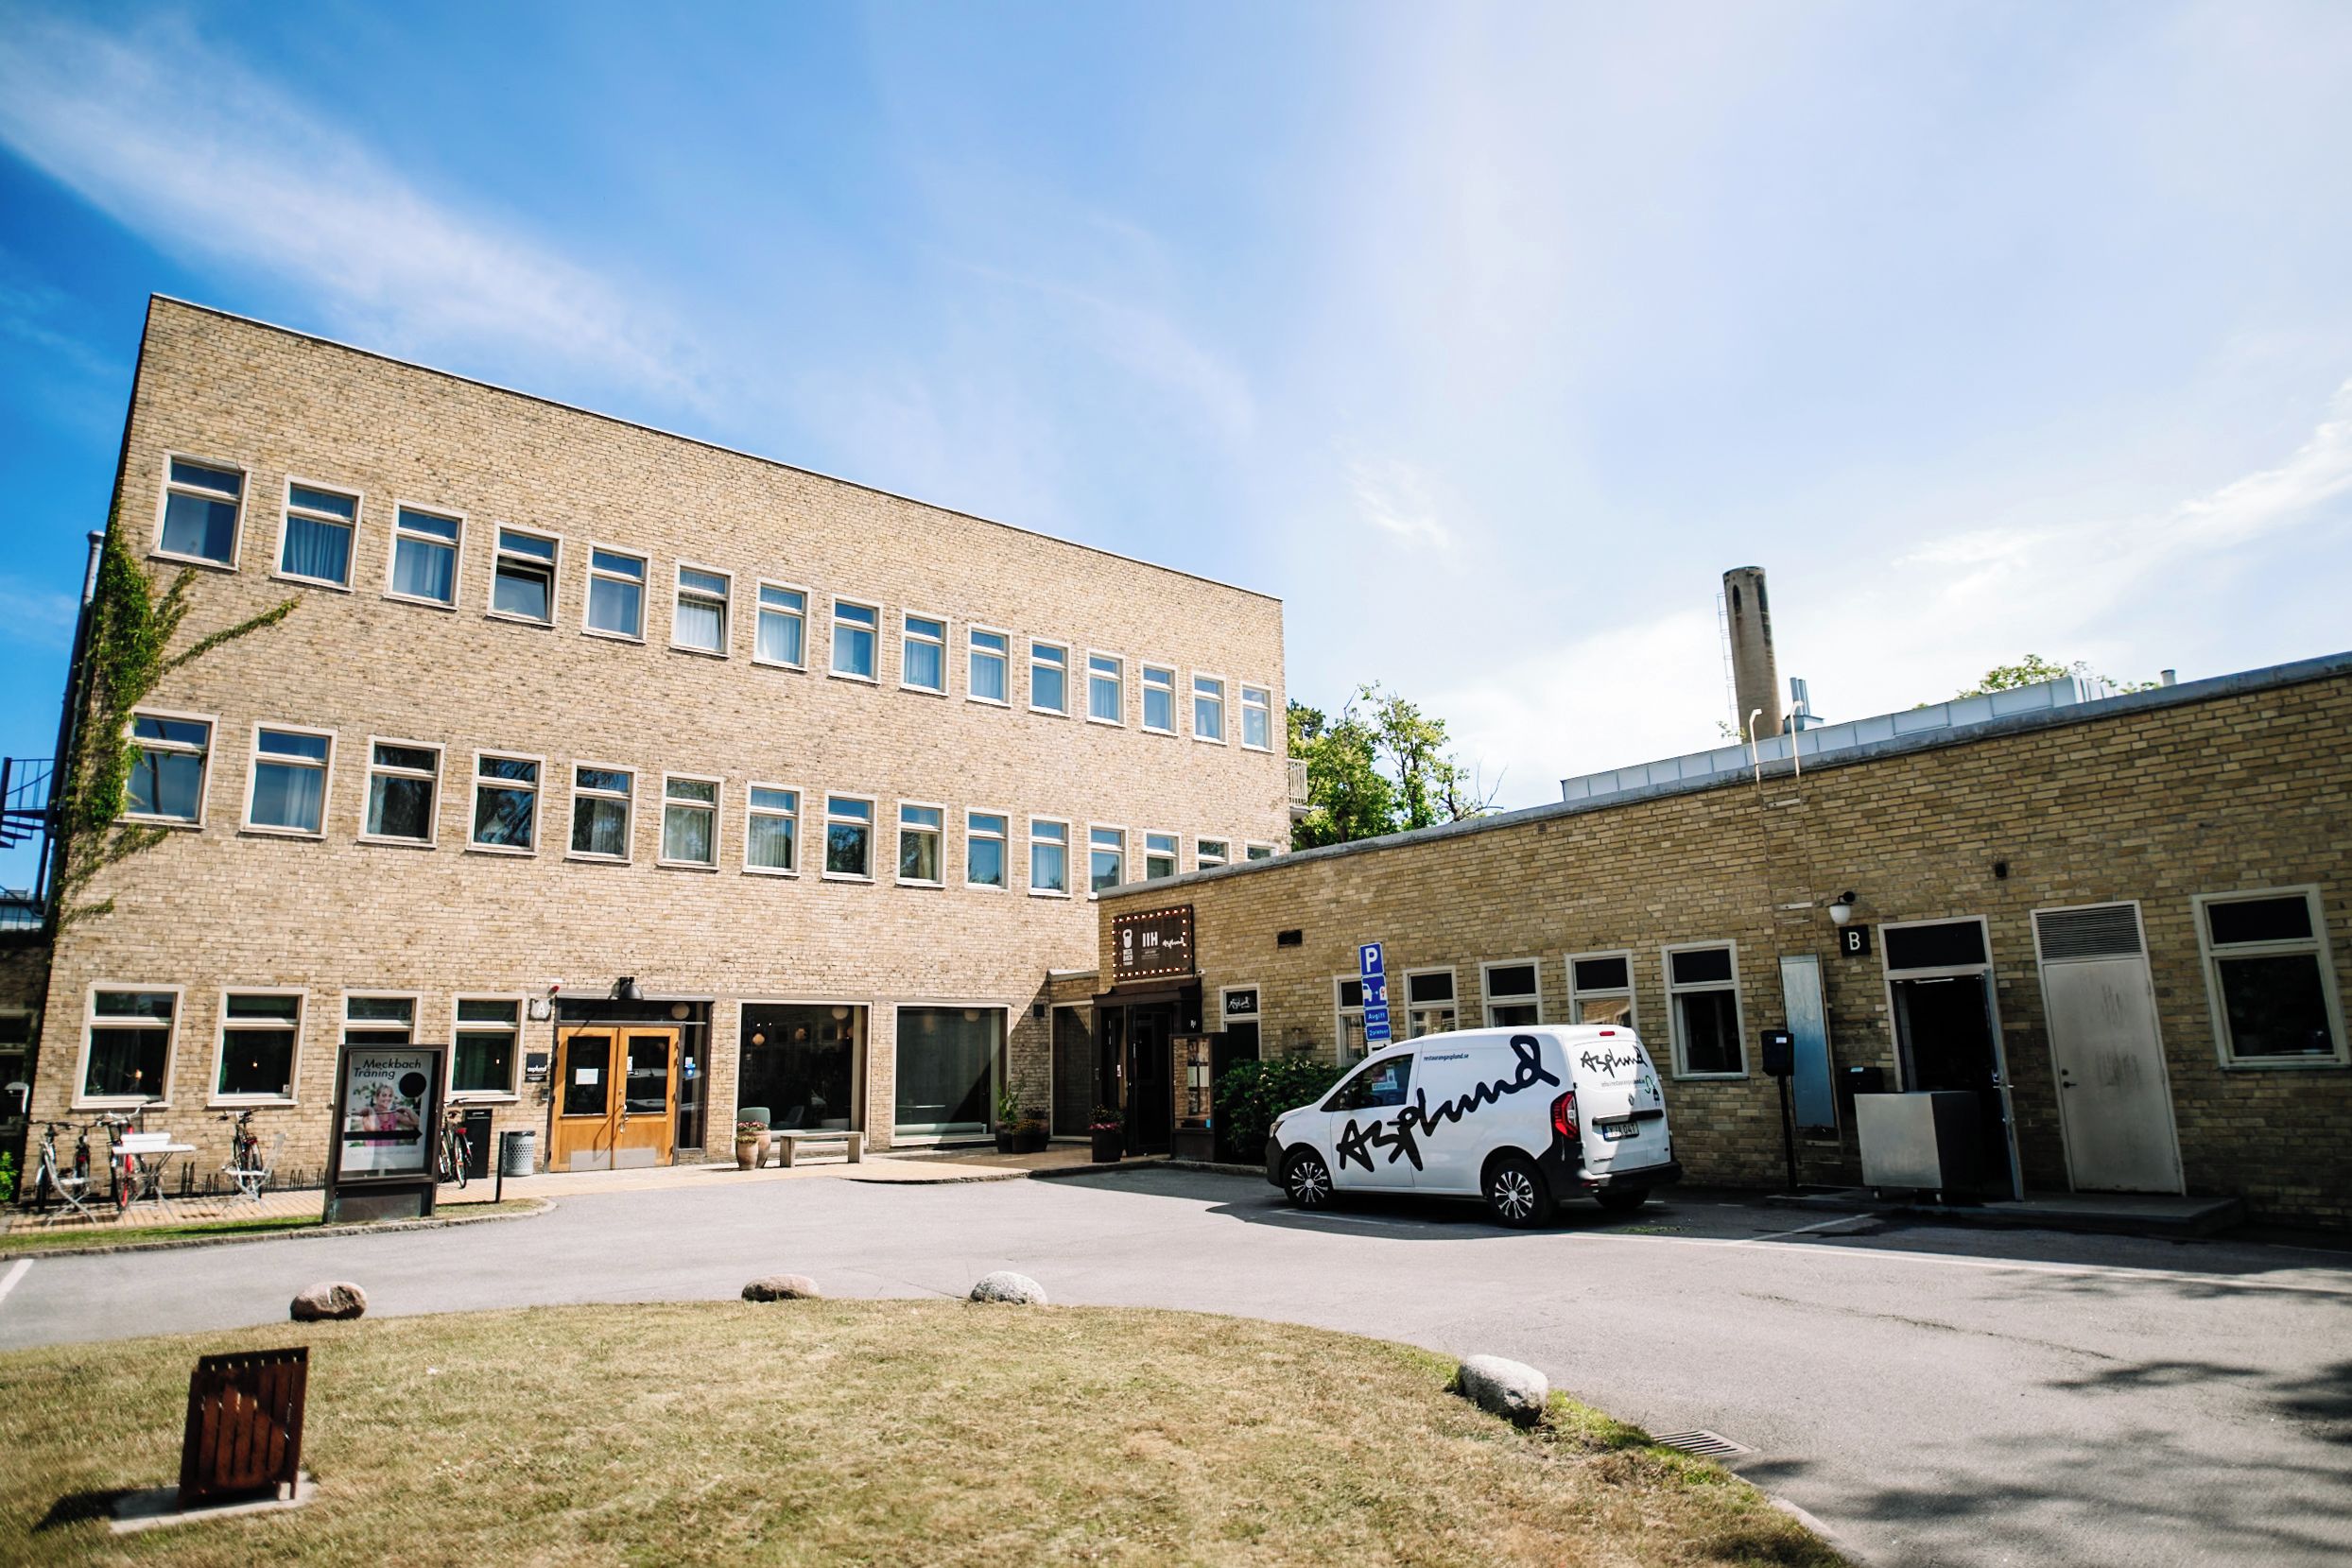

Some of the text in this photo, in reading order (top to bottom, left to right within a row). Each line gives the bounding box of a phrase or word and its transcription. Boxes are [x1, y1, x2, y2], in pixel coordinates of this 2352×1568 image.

[1848, 931, 1860, 951] B
[1365, 947, 1378, 973] P
[536, 1005, 546, 1016] A
[363, 1058, 422, 1069] Meckbach
[1336, 1034, 1560, 1173] Asplund
